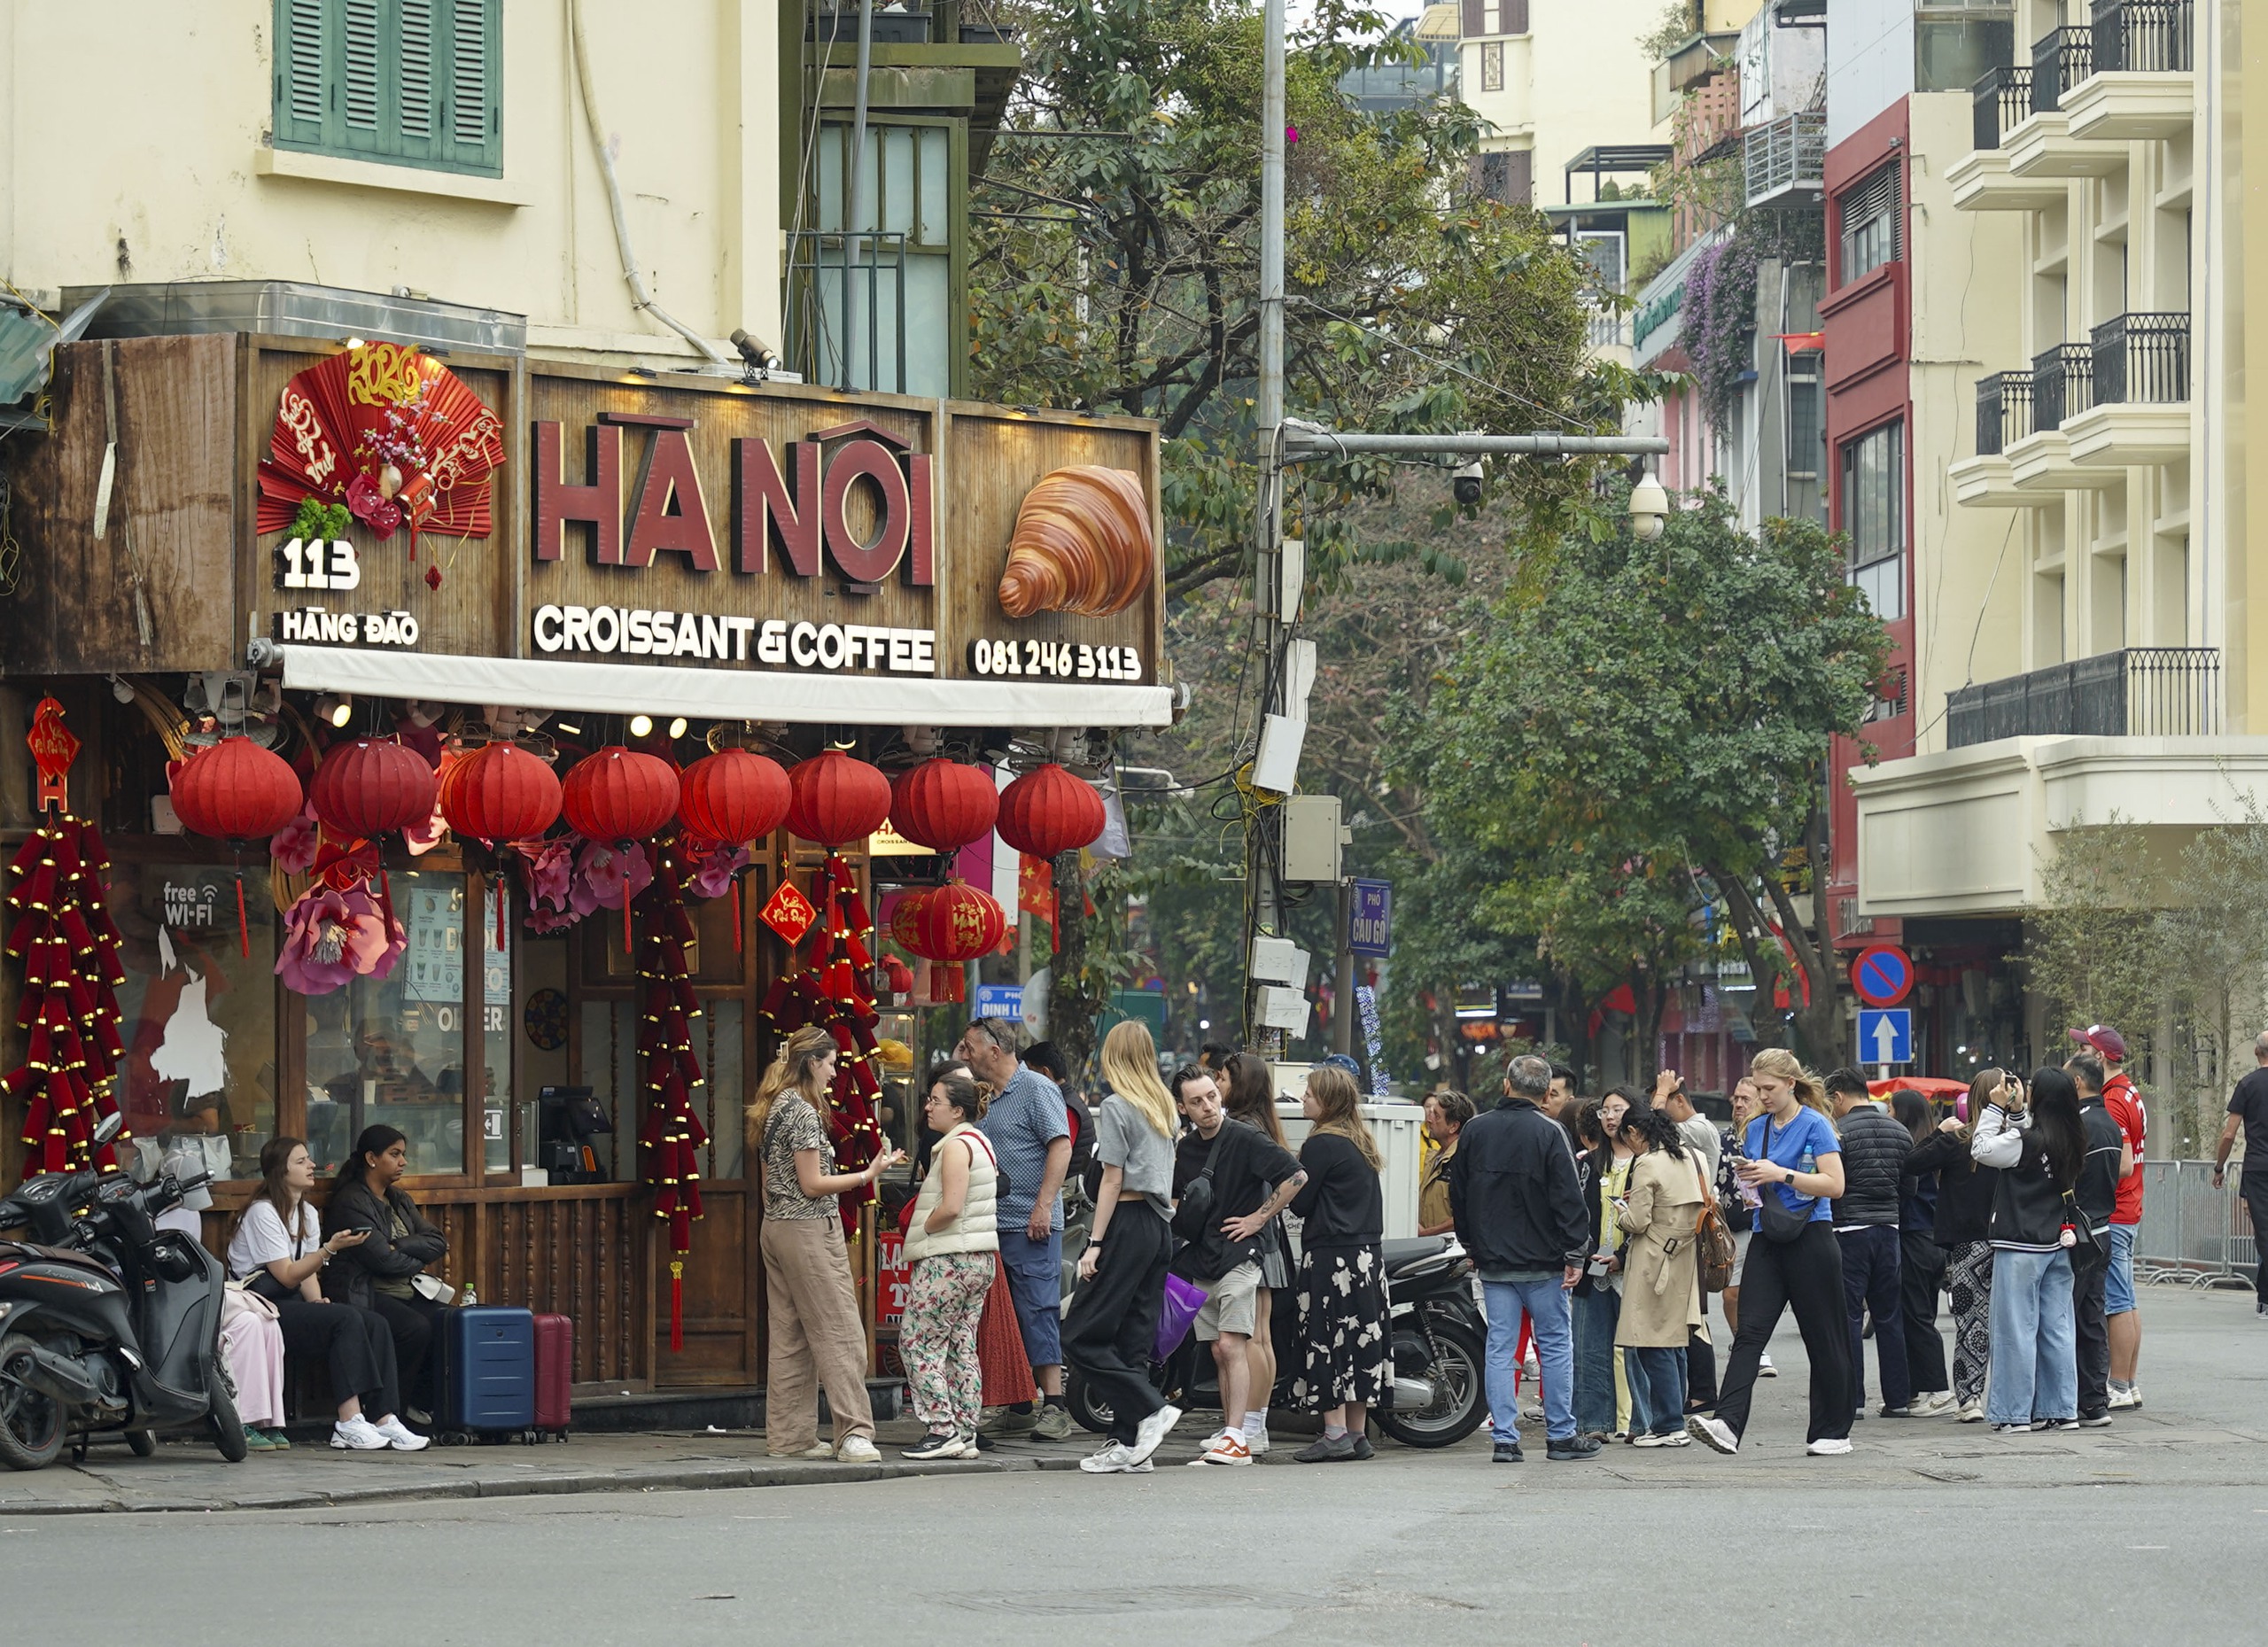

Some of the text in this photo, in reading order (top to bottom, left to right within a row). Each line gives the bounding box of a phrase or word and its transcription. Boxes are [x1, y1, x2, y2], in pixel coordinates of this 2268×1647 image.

[283, 537, 361, 591] 113
[164, 882, 197, 902] free
[1367, 889, 1381, 906] PHỐ
